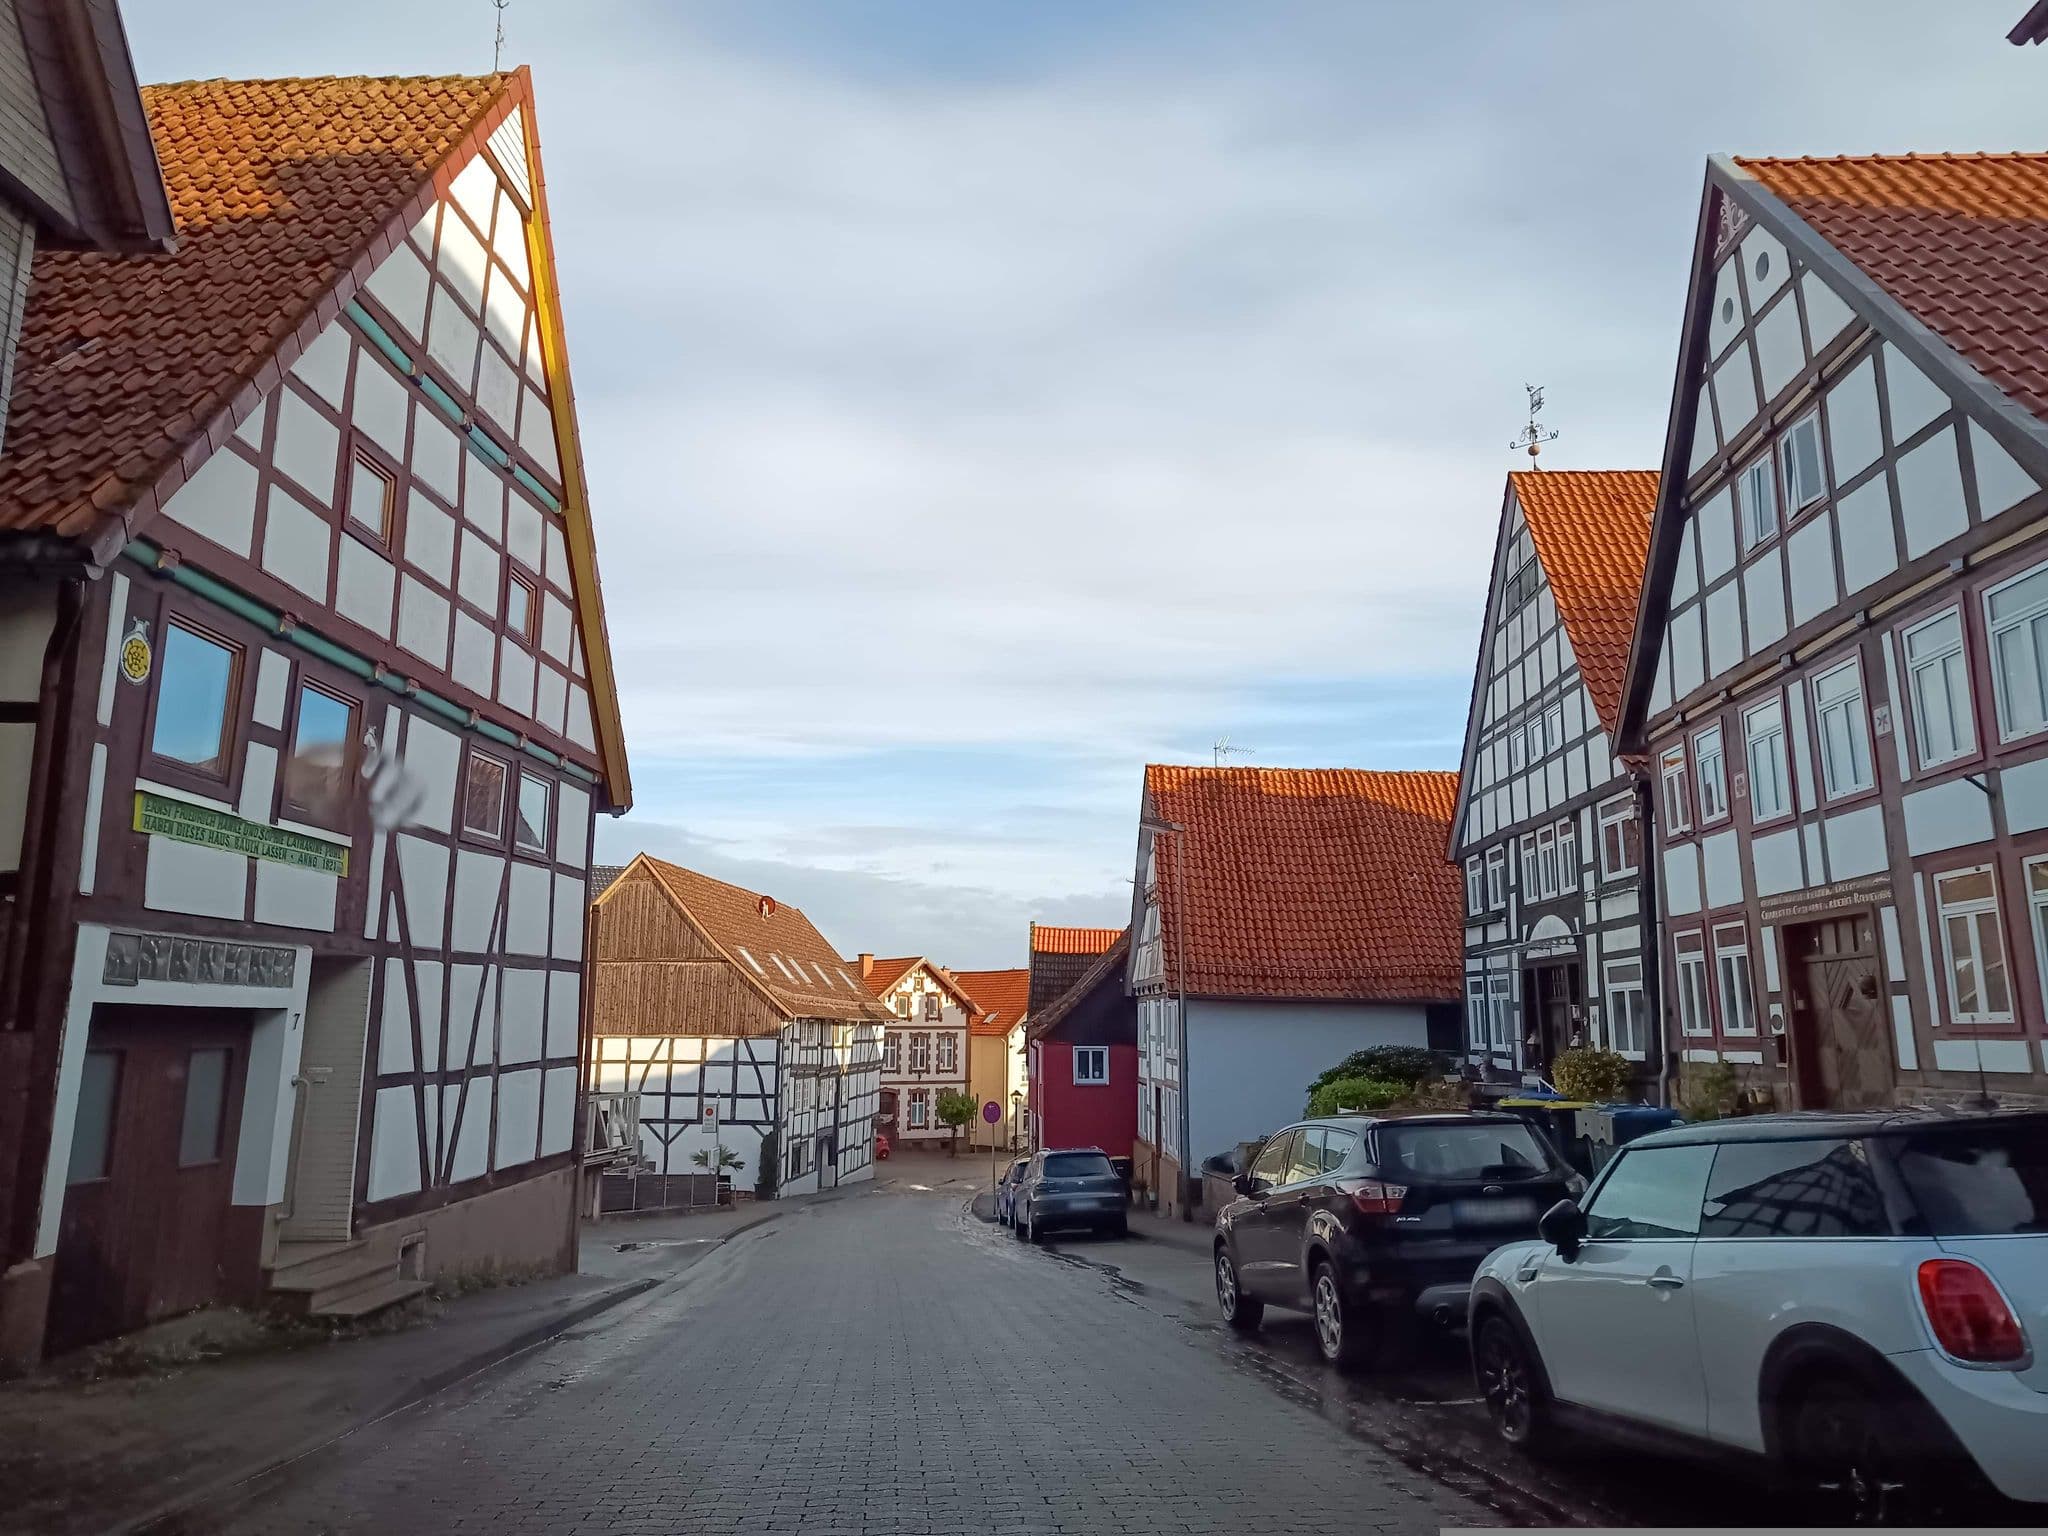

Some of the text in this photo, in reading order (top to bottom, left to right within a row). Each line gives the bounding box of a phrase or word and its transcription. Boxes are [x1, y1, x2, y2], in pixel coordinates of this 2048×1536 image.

[143, 815, 174, 835] HABEN
[176, 822, 206, 841] DIESES
[208, 829, 231, 848] HAUS
[233, 836, 259, 853] BAUEN
[261, 843, 287, 860] LASSEN
[298, 853, 318, 867] ANNO
[293, 1013, 301, 1030] 7
